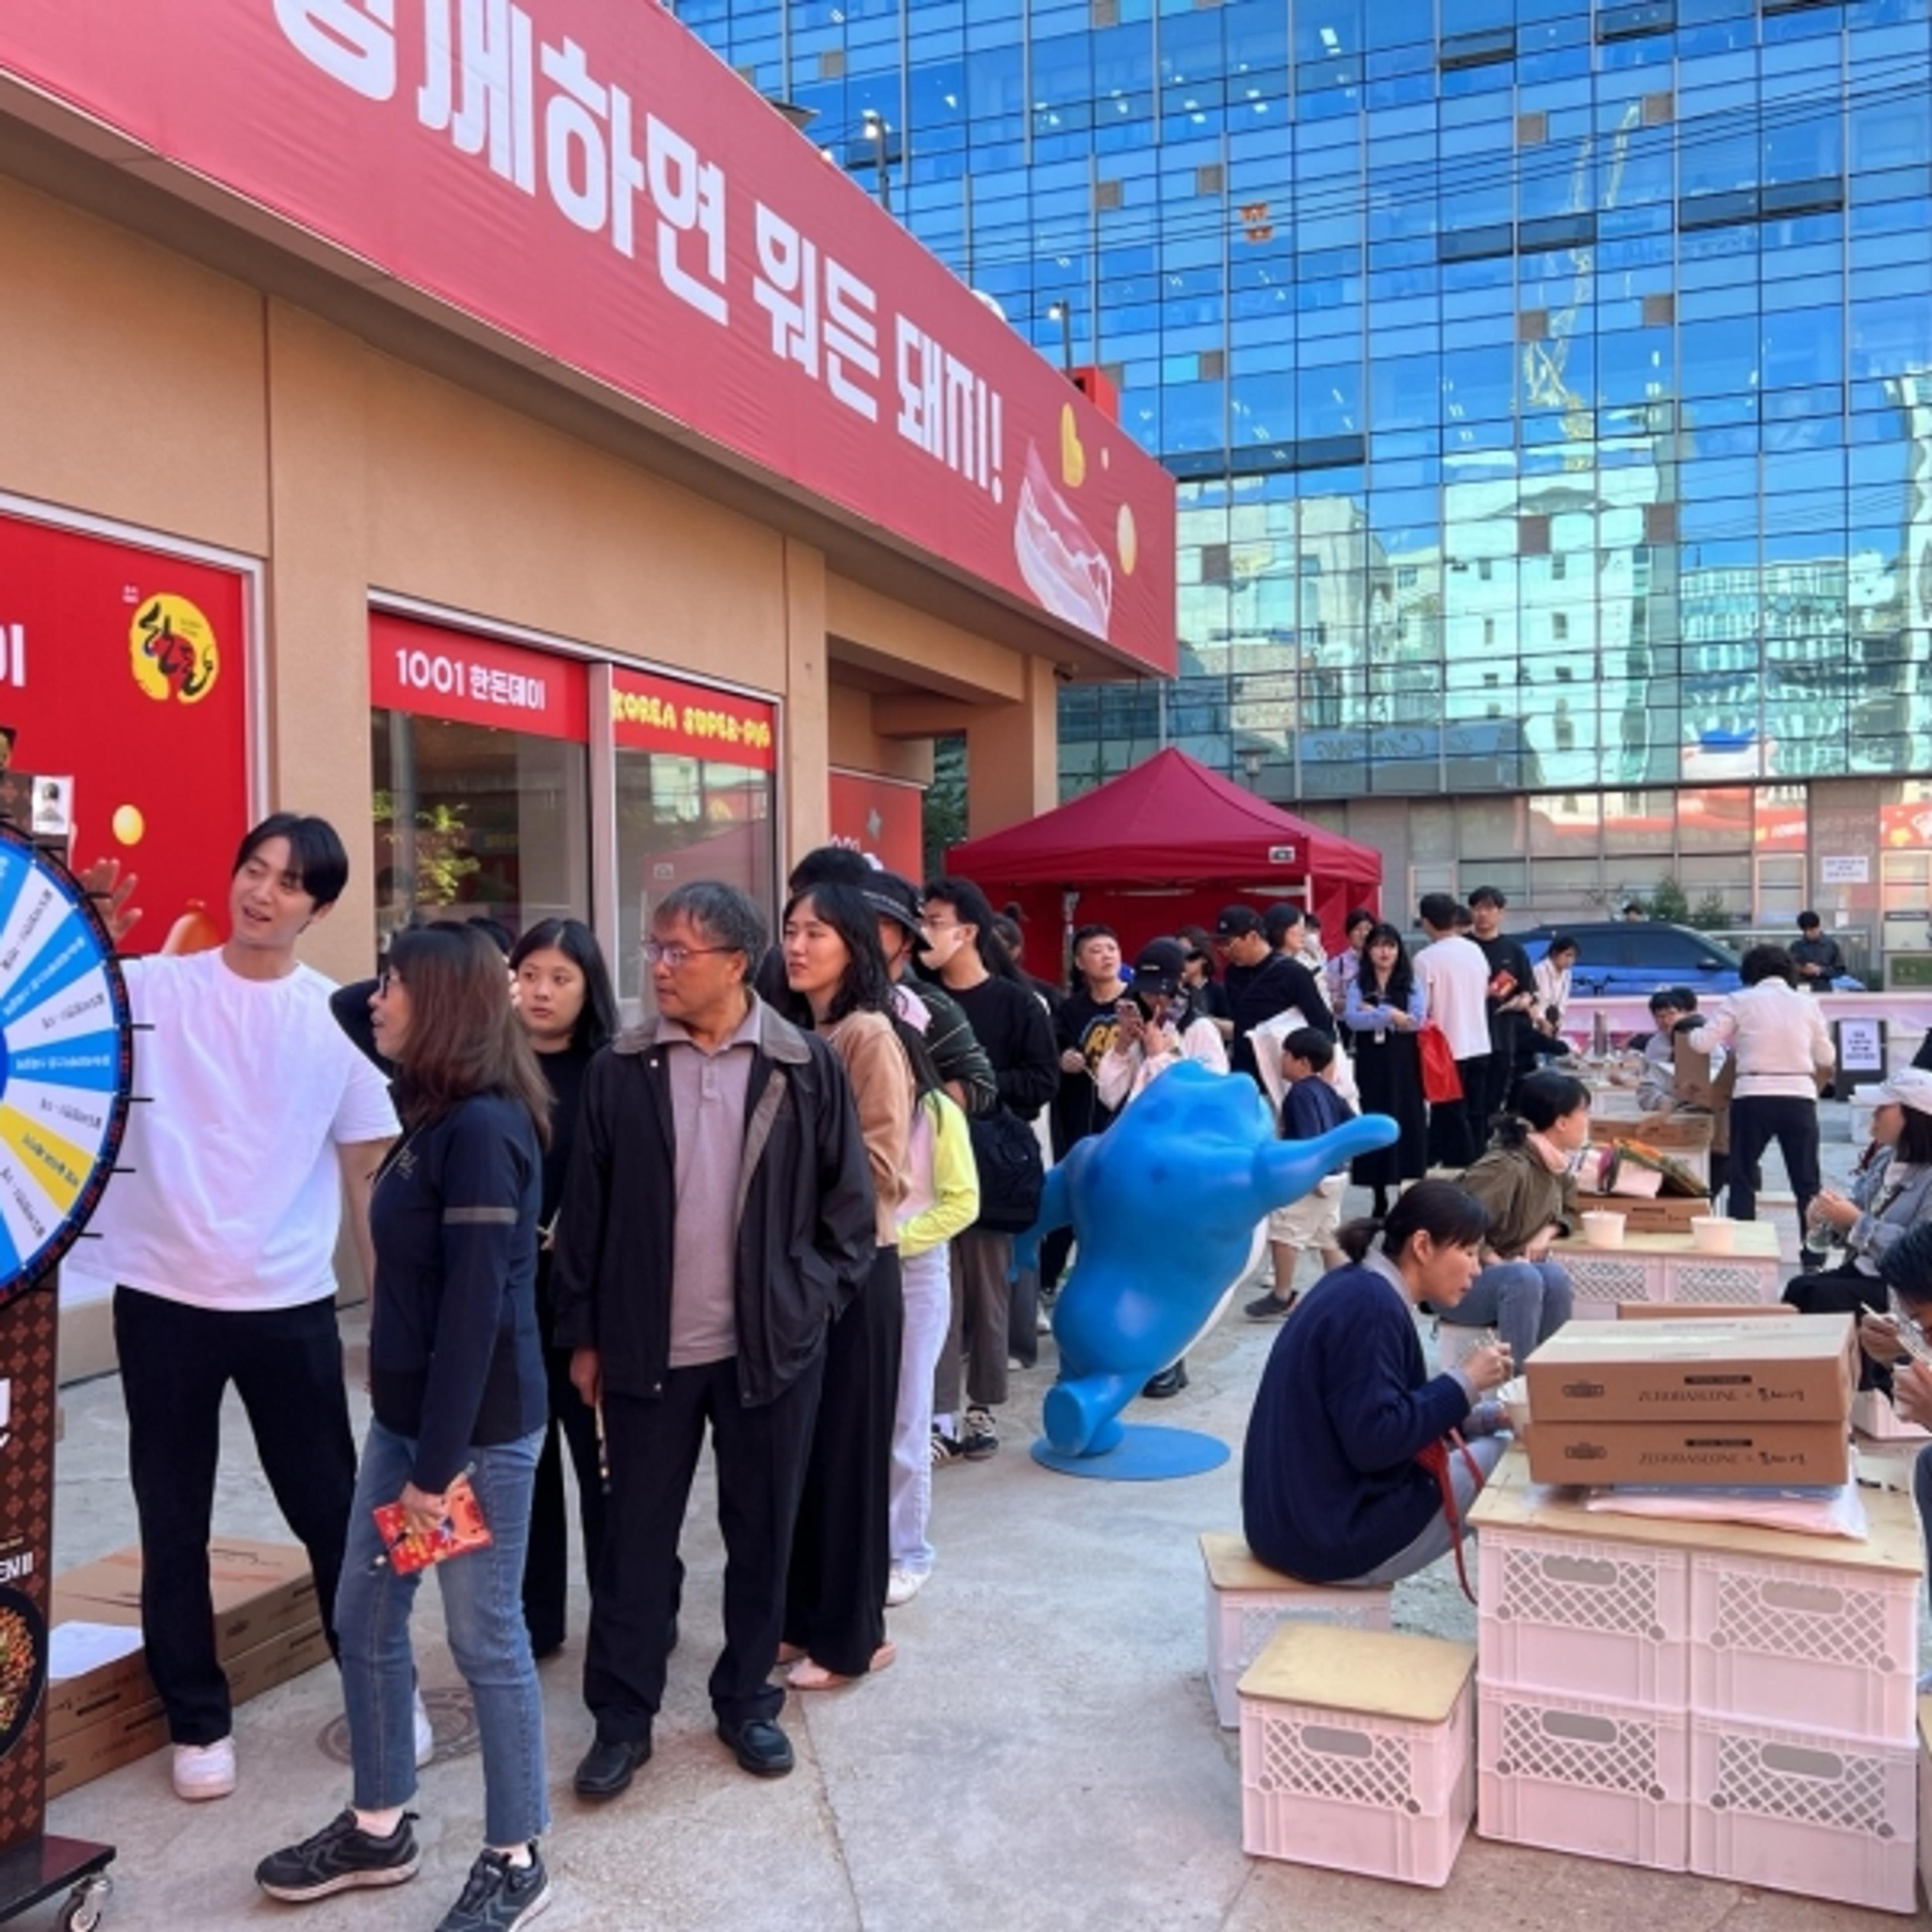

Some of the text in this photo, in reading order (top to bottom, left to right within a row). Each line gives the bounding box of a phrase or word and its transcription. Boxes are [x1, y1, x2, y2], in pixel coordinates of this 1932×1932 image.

[753, 200, 880, 423] 뭐든
[395, 649, 545, 710] 1001 한돈데이
[612, 688, 677, 732] KOREA
